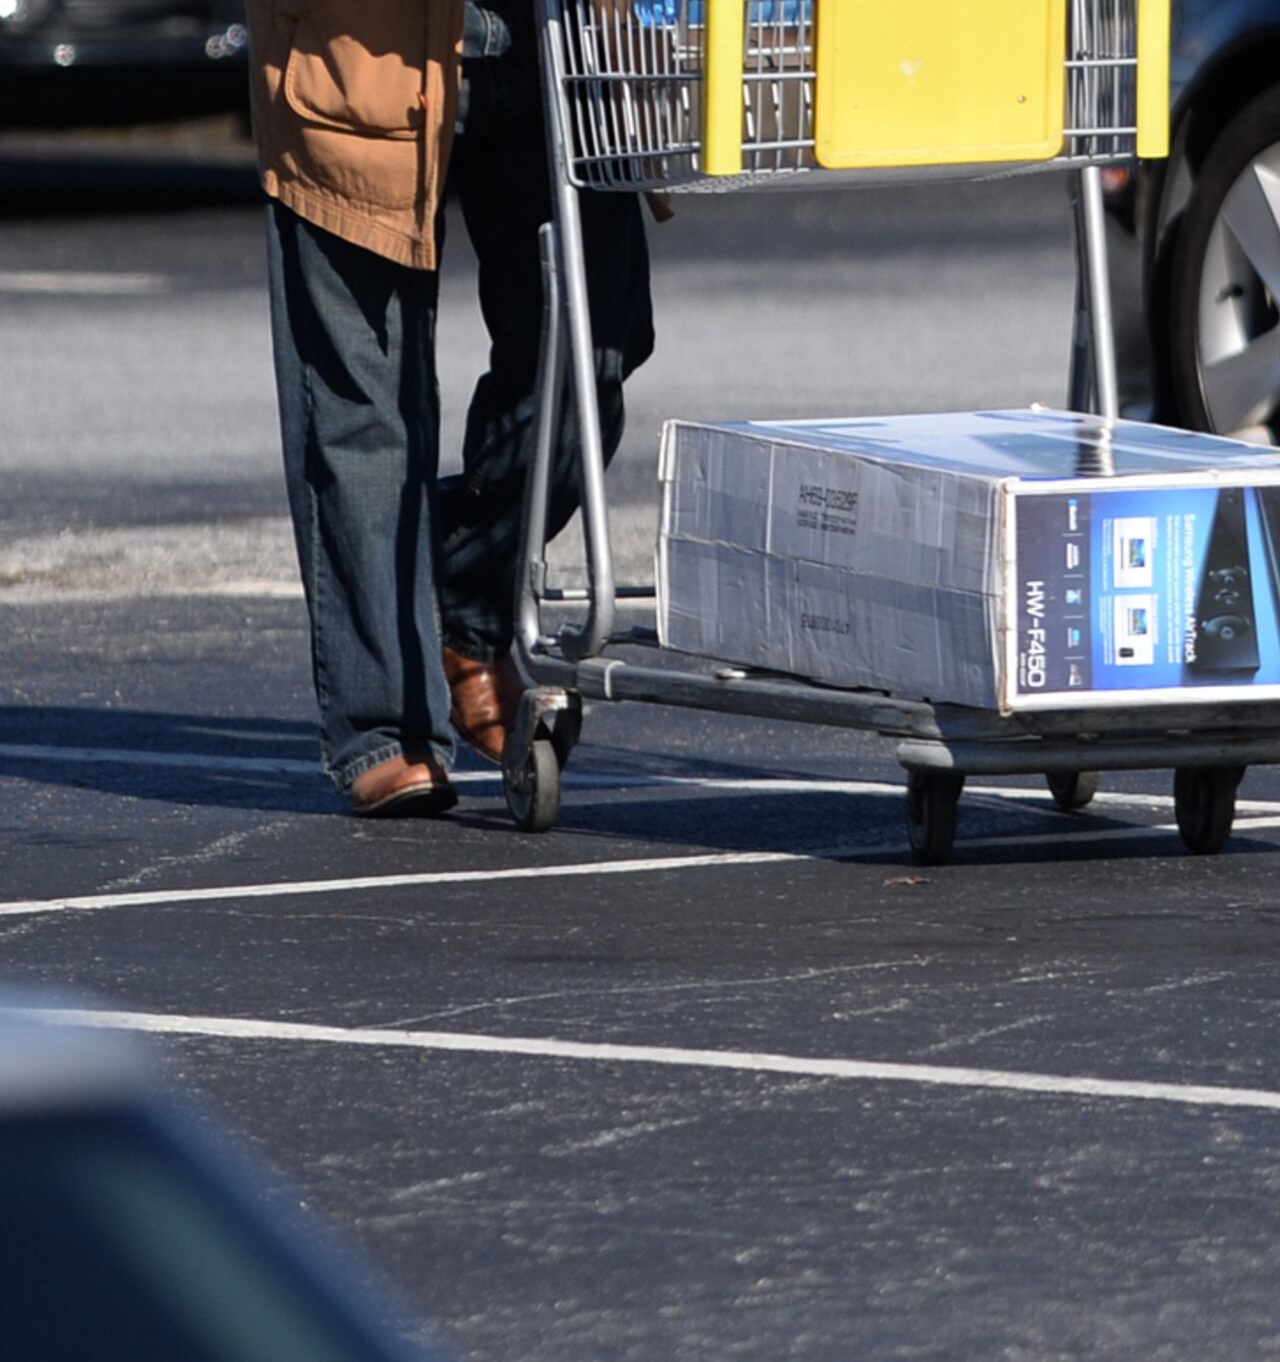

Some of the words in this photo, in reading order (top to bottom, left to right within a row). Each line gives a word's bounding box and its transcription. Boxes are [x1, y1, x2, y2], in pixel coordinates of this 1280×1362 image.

[1182, 513, 1196, 567] Samsung
[1184, 568, 1196, 615] Wireless
[1025, 580, 1046, 688] HW-F450
[1185, 615, 1197, 663] AirTrack
